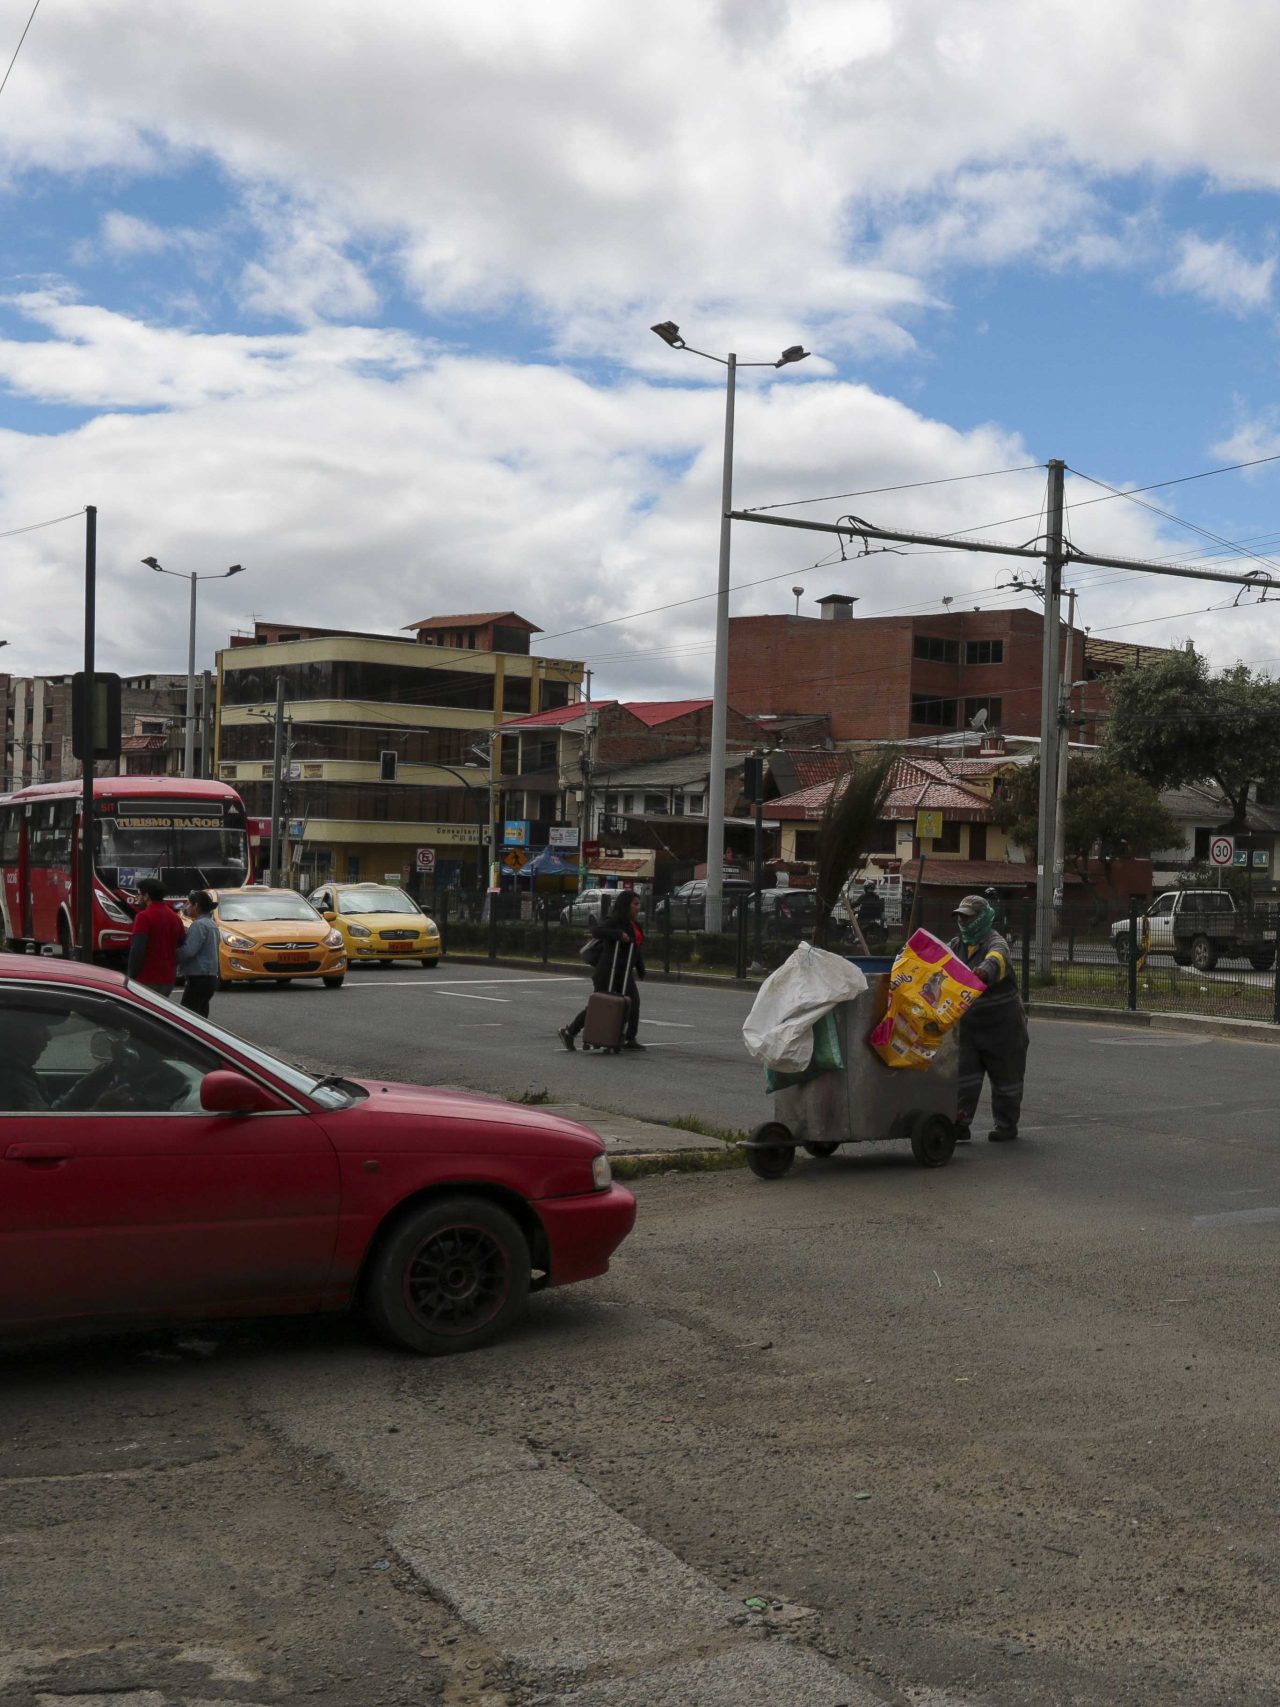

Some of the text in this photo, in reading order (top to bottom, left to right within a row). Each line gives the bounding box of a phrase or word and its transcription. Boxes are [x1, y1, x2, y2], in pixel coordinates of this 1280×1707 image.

[117, 817, 172, 827] TURISMO
[1215, 845, 1228, 857] 30
[120, 875, 134, 886] 27
